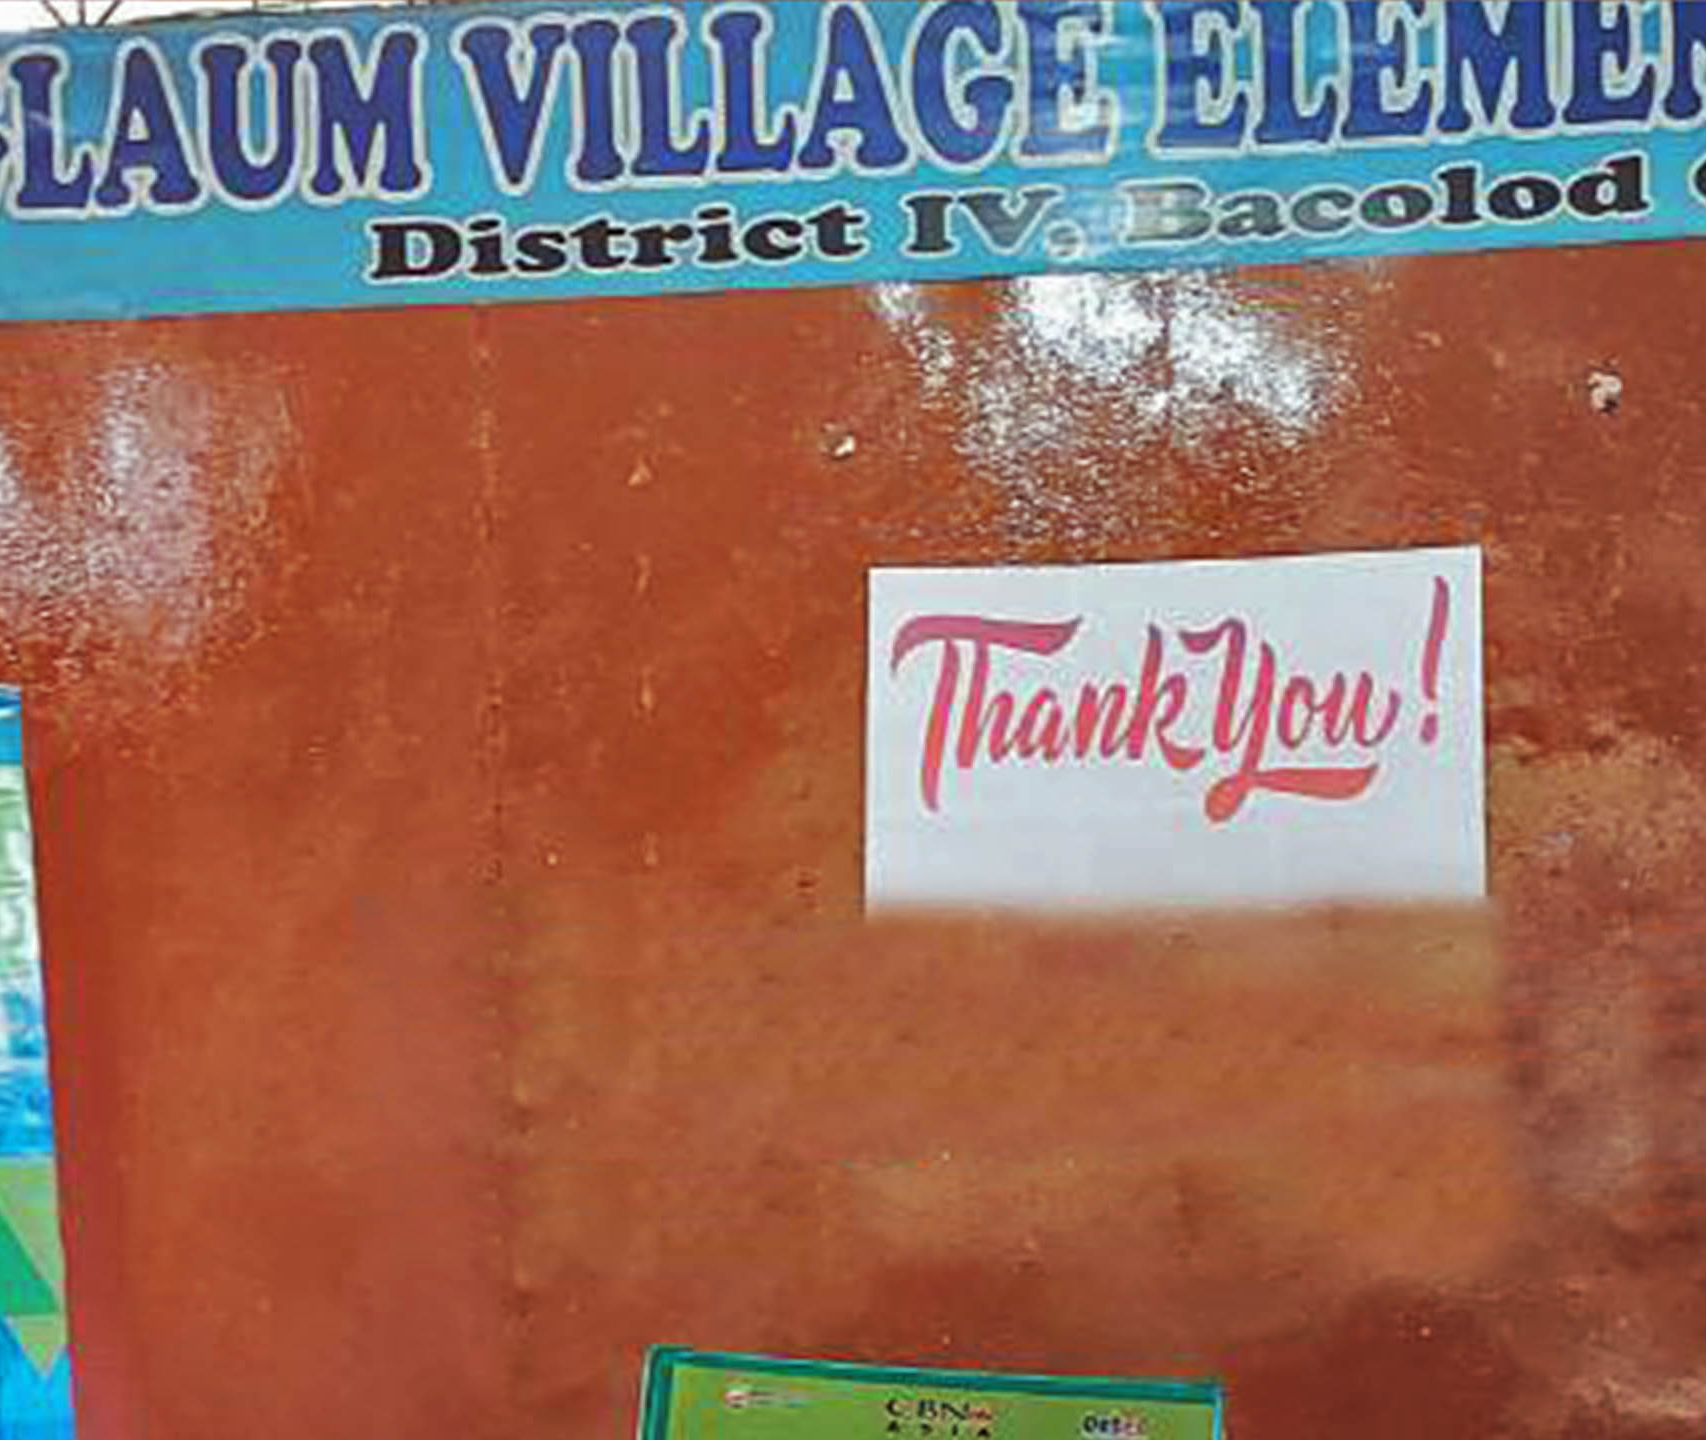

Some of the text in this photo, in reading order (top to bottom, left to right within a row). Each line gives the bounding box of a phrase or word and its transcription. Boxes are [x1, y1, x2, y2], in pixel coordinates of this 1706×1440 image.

[456, 0, 1117, 188] VILLAGE
[371, 205, 864, 280] District
[1124, 154, 1646, 241] Bacolod
[892, 614, 1205, 813] Thank
